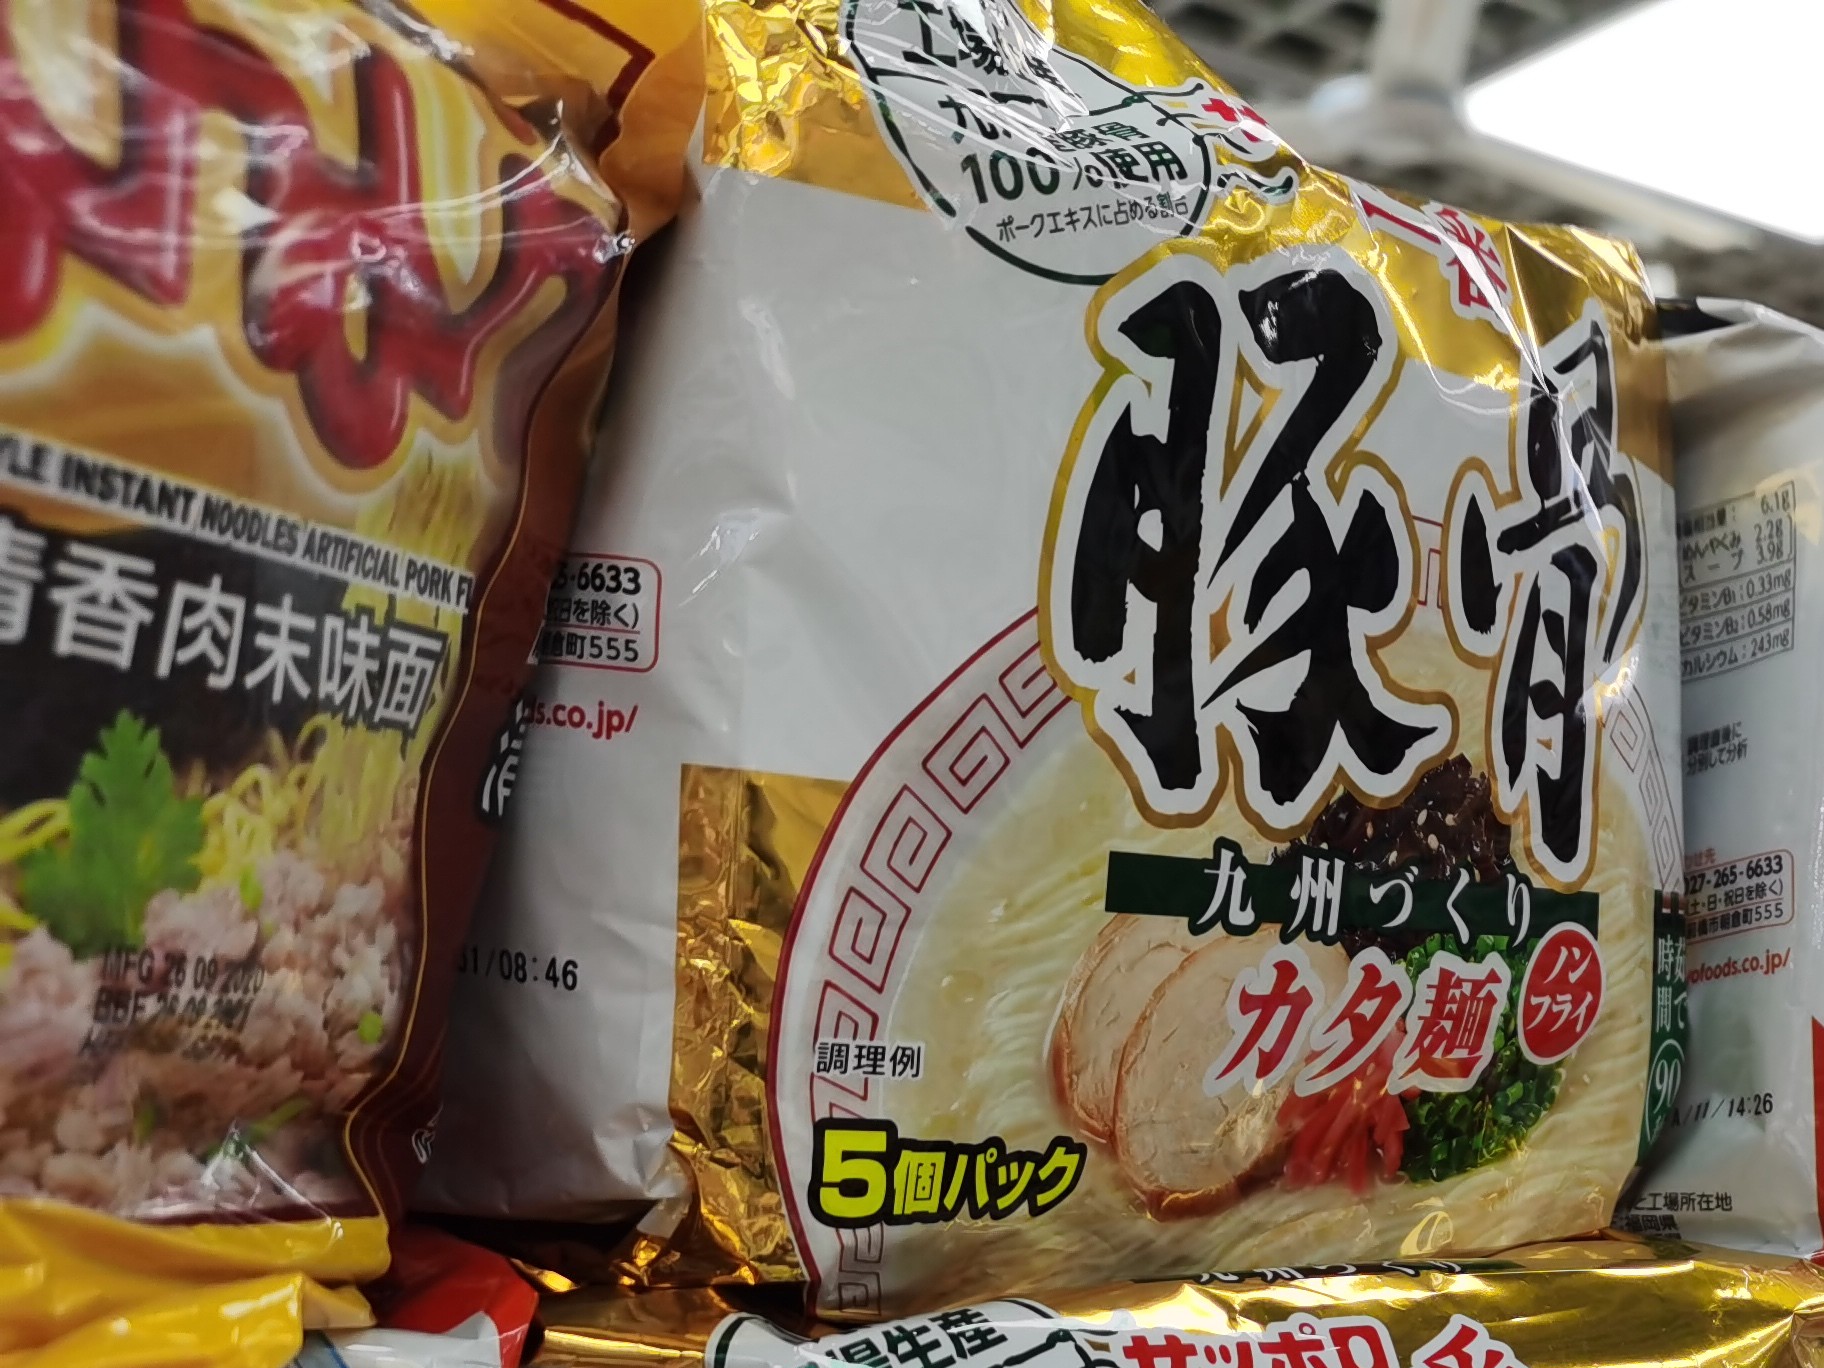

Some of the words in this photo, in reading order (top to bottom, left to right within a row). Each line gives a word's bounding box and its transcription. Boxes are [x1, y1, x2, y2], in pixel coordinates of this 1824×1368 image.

[60, 453, 198, 526] INSTANT
[203, 495, 299, 556] NOODLES
[302, 530, 400, 588] ARTIFICIAL
[404, 559, 455, 601] PORK
[1071, 268, 1641, 862] 豚骨
[541, 631, 640, 663] 倉町555
[546, 598, 640, 629] 日を除く)
[1196, 847, 1533, 948] 九州づくり
[1544, 944, 1594, 985] ノン
[1215, 959, 1503, 1080] カタ麺
[1527, 992, 1595, 1036] フライ
[816, 1041, 922, 1078] 調理例
[818, 1129, 1082, 1219] 5個パック
